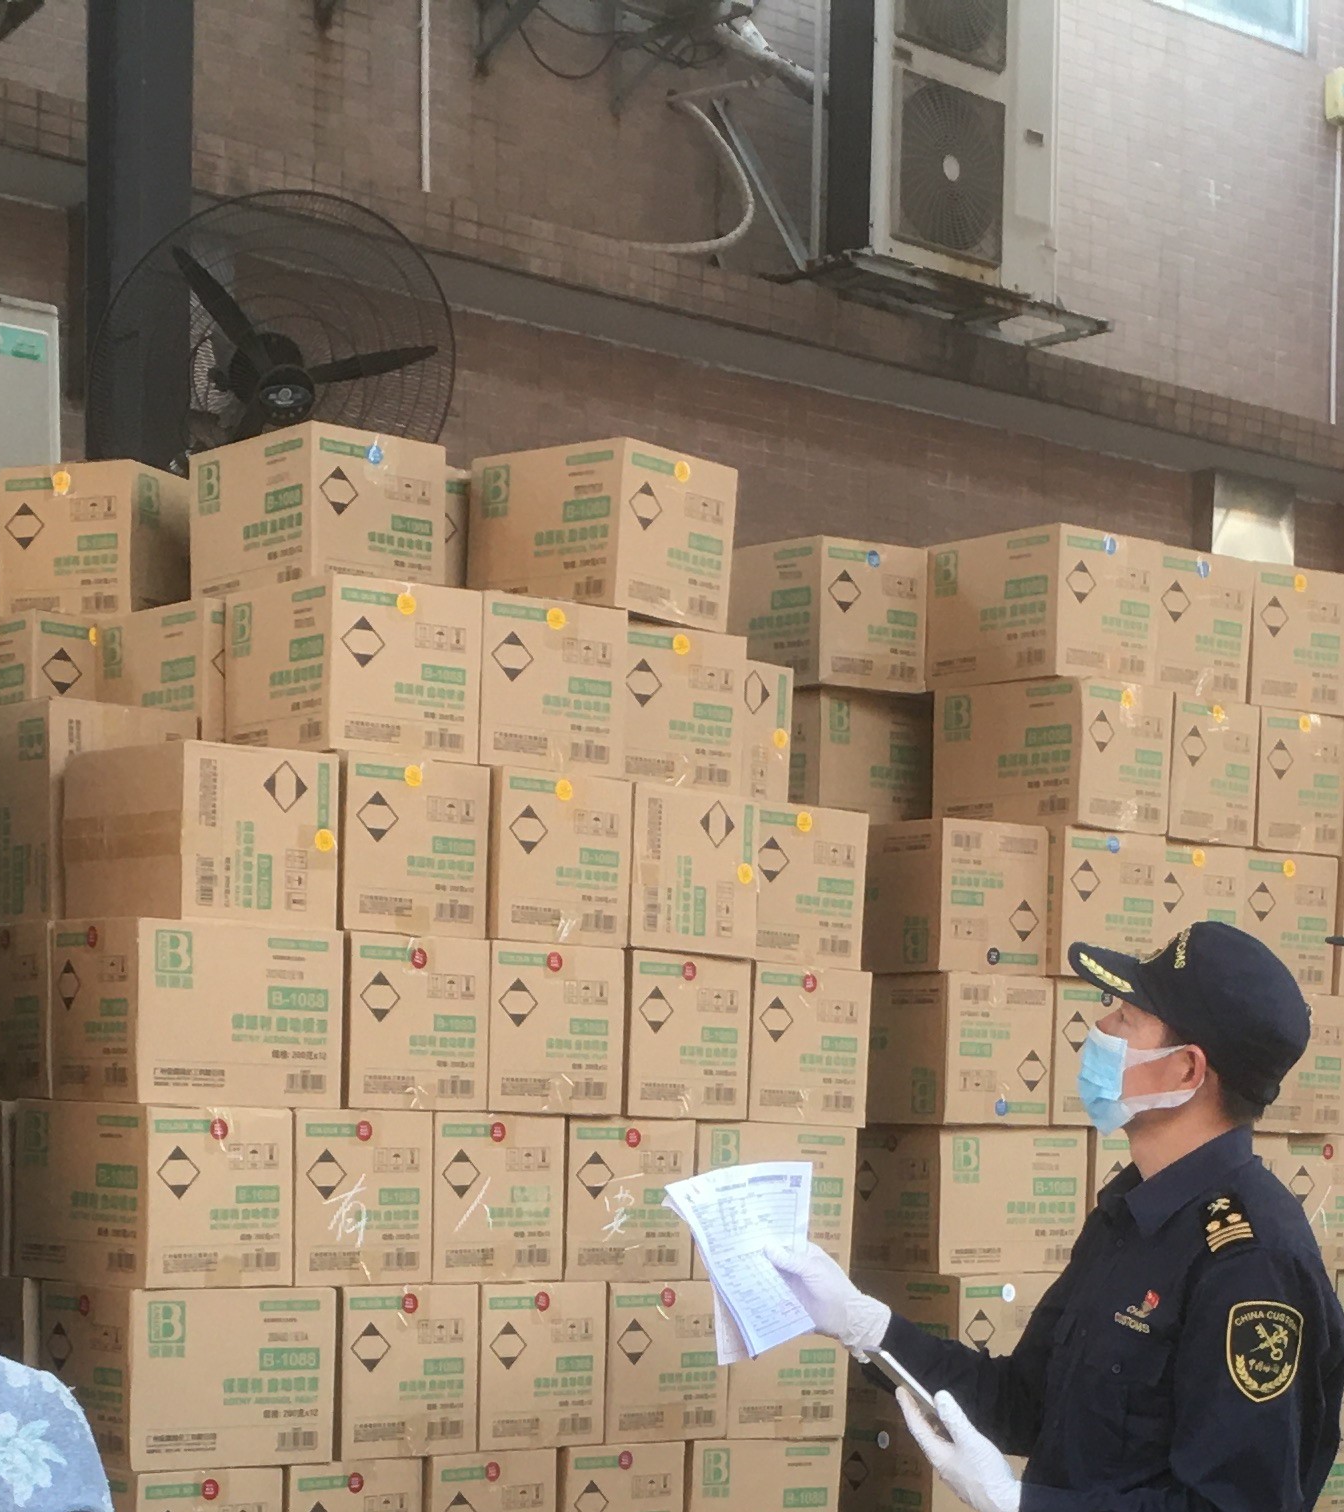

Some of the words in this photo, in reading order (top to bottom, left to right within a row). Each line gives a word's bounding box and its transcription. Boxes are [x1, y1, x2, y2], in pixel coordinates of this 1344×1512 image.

[272, 991, 326, 1007] B-1088
[1235, 1310, 1265, 1326] CHINA
[263, 1352, 316, 1367] B-1088
